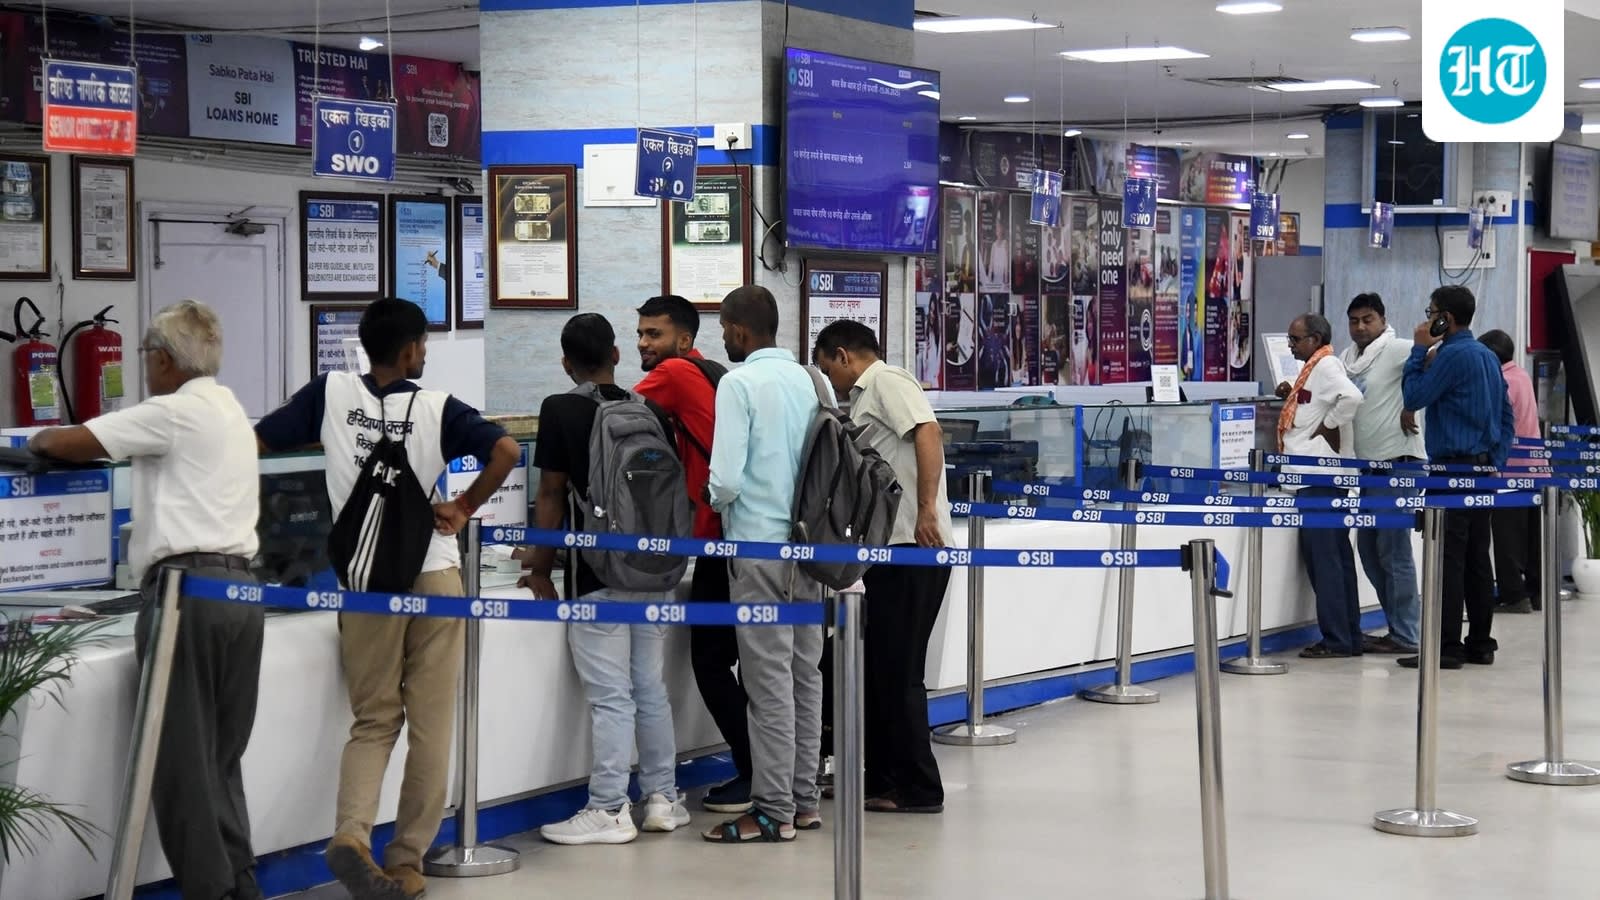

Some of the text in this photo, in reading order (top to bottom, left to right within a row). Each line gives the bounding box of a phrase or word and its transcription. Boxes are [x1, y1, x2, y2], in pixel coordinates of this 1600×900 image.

[297, 48, 368, 70] TRUSTED HAI
[801, 54, 810, 65] SBI
[209, 64, 274, 82] Sabko Pata Hai
[406, 64, 418, 75] SBI
[798, 68, 813, 88] SBI
[76, 72, 106, 102] नागरिक
[234, 91, 252, 105] SBI
[206, 106, 279, 126] LOANS HOME
[320, 106, 390, 132] एकल खिड़की
[353, 136, 360, 148] 1
[642, 136, 694, 158] एकल खिड़की
[331, 154, 378, 174] SWO
[320, 204, 334, 218] SBI
[1101, 210, 1119, 230] you
[1130, 213, 1150, 226] SWO
[1101, 226, 1122, 250] only
[1256, 224, 1274, 236] SWO
[1101, 246, 1124, 266] need
[820, 273, 834, 292] SBI
[1101, 270, 1118, 285] one
[462, 454, 478, 471] SBI
[1276, 456, 1392, 469] SBI SBI SBI
[11, 477, 35, 496] SBI
[1179, 468, 1597, 488] SBI SBI SBI SBI SBI SBI SBI SBI
[1032, 485, 1494, 507] SBI SBI SBI SBI SBI SBI SBI SBI
[953, 502, 1376, 526] SBI SBI SBI SBI SBI SBI SBI
[506, 529, 1138, 565] SBI SBI SBI SBI SBI SBI SBI SBI SBI
[240, 586, 778, 623] SBI SBI SBI SBI SBI SBI SBI
